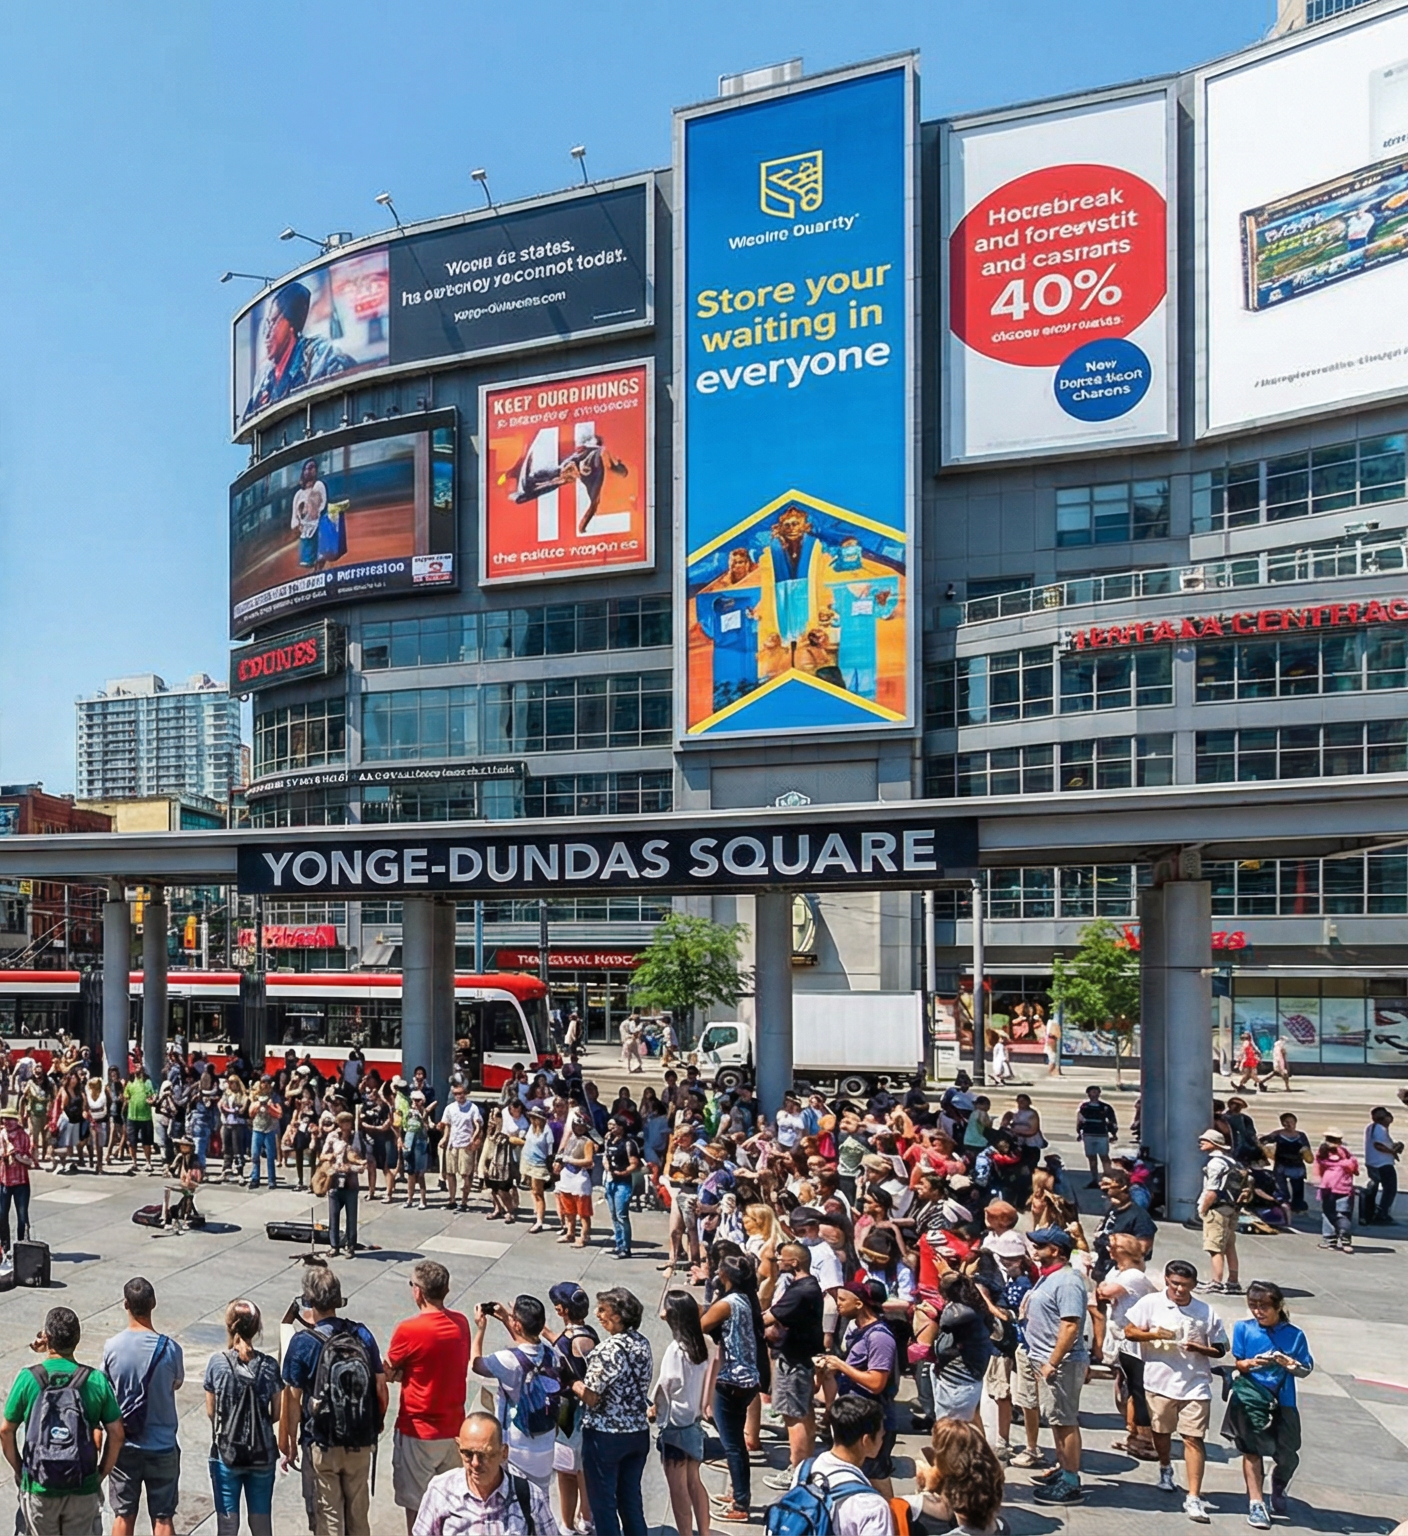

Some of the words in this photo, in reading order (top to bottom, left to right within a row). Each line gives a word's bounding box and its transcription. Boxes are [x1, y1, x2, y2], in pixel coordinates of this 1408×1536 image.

[974, 229, 1019, 252] and
[981, 253, 1026, 276] and
[696, 281, 796, 319] Store
[805, 263, 892, 306] your
[990, 262, 1123, 321] 40%
[701, 311, 837, 354] waiting
[848, 299, 883, 329] in
[695, 341, 891, 394] everyone
[261, 836, 674, 887] YONGE-DUNDAS
[688, 828, 938, 879] SQUARE
